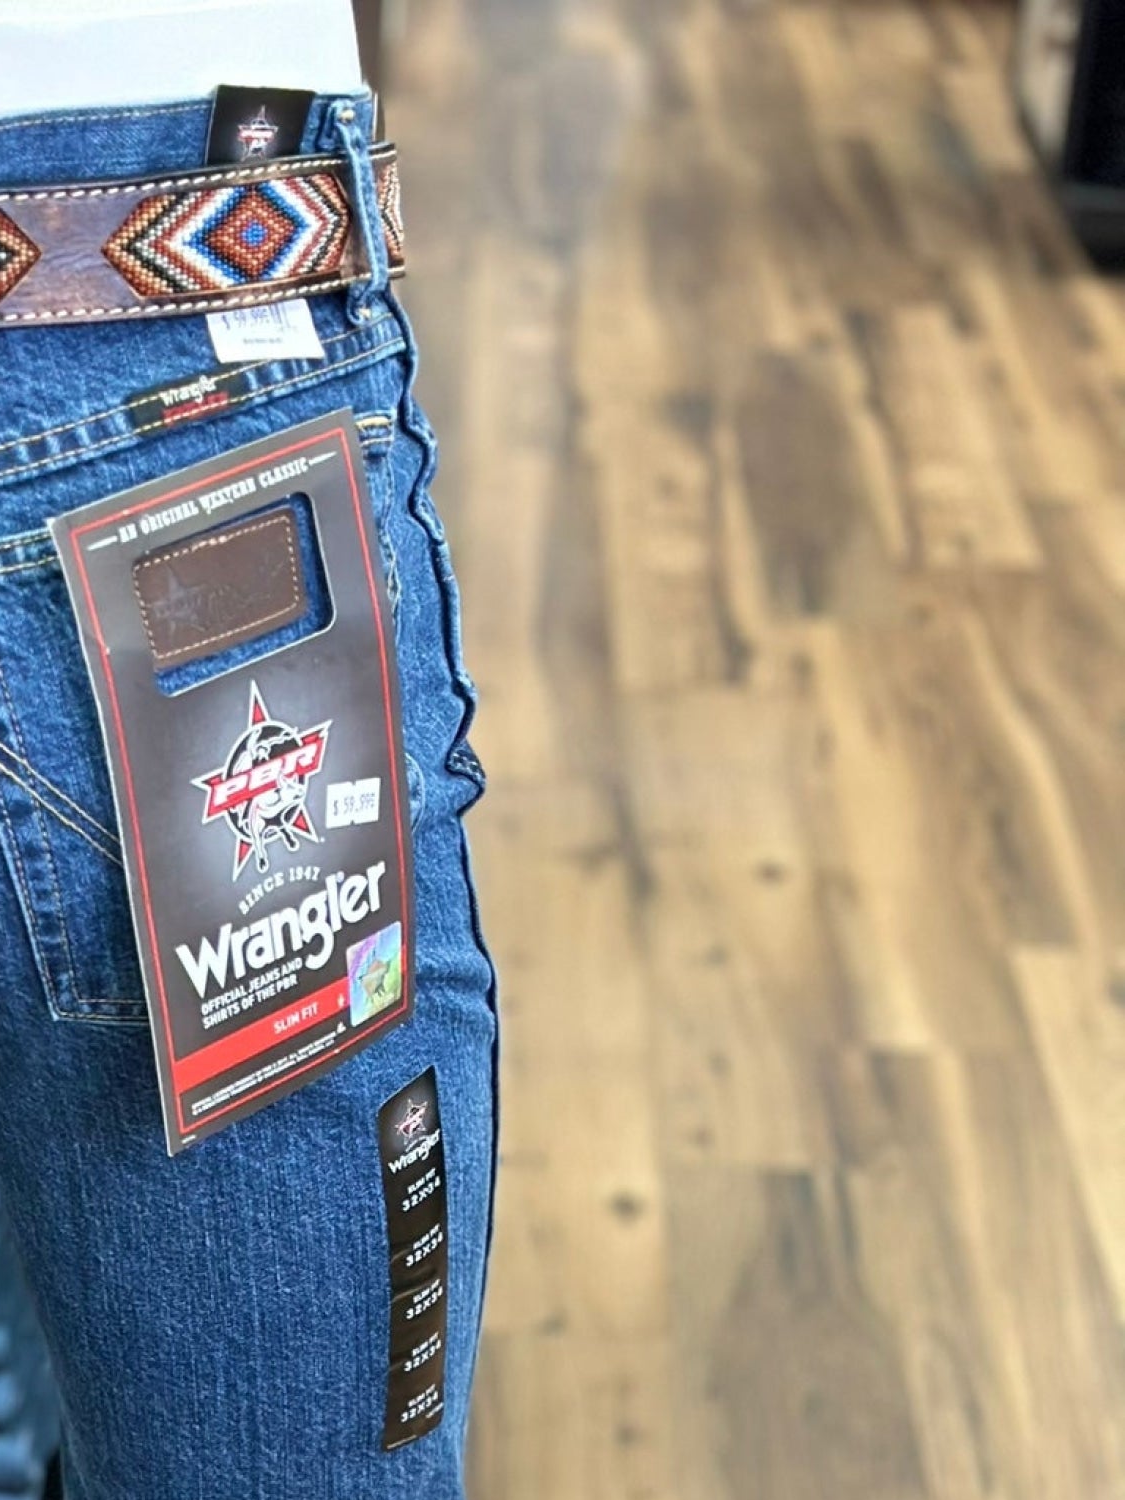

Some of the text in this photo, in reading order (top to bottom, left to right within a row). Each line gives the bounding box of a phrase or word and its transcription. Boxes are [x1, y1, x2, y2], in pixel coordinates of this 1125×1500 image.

[139, 499, 199, 535] ORIGINAL
[198, 476, 257, 514] WESTERN
[258, 456, 310, 489] CLASSIC
[211, 741, 322, 807] PBR
[238, 865, 322, 916] SINCE 1947
[175, 861, 386, 999] Wrangler
[201, 957, 303, 1016] OFFICIAL JEANS AND
[202, 973, 299, 1030] SHIRTS OF THE PBR
[273, 1001, 318, 1035] SLIM FIT
[388, 1128, 441, 1174] Wrangler
